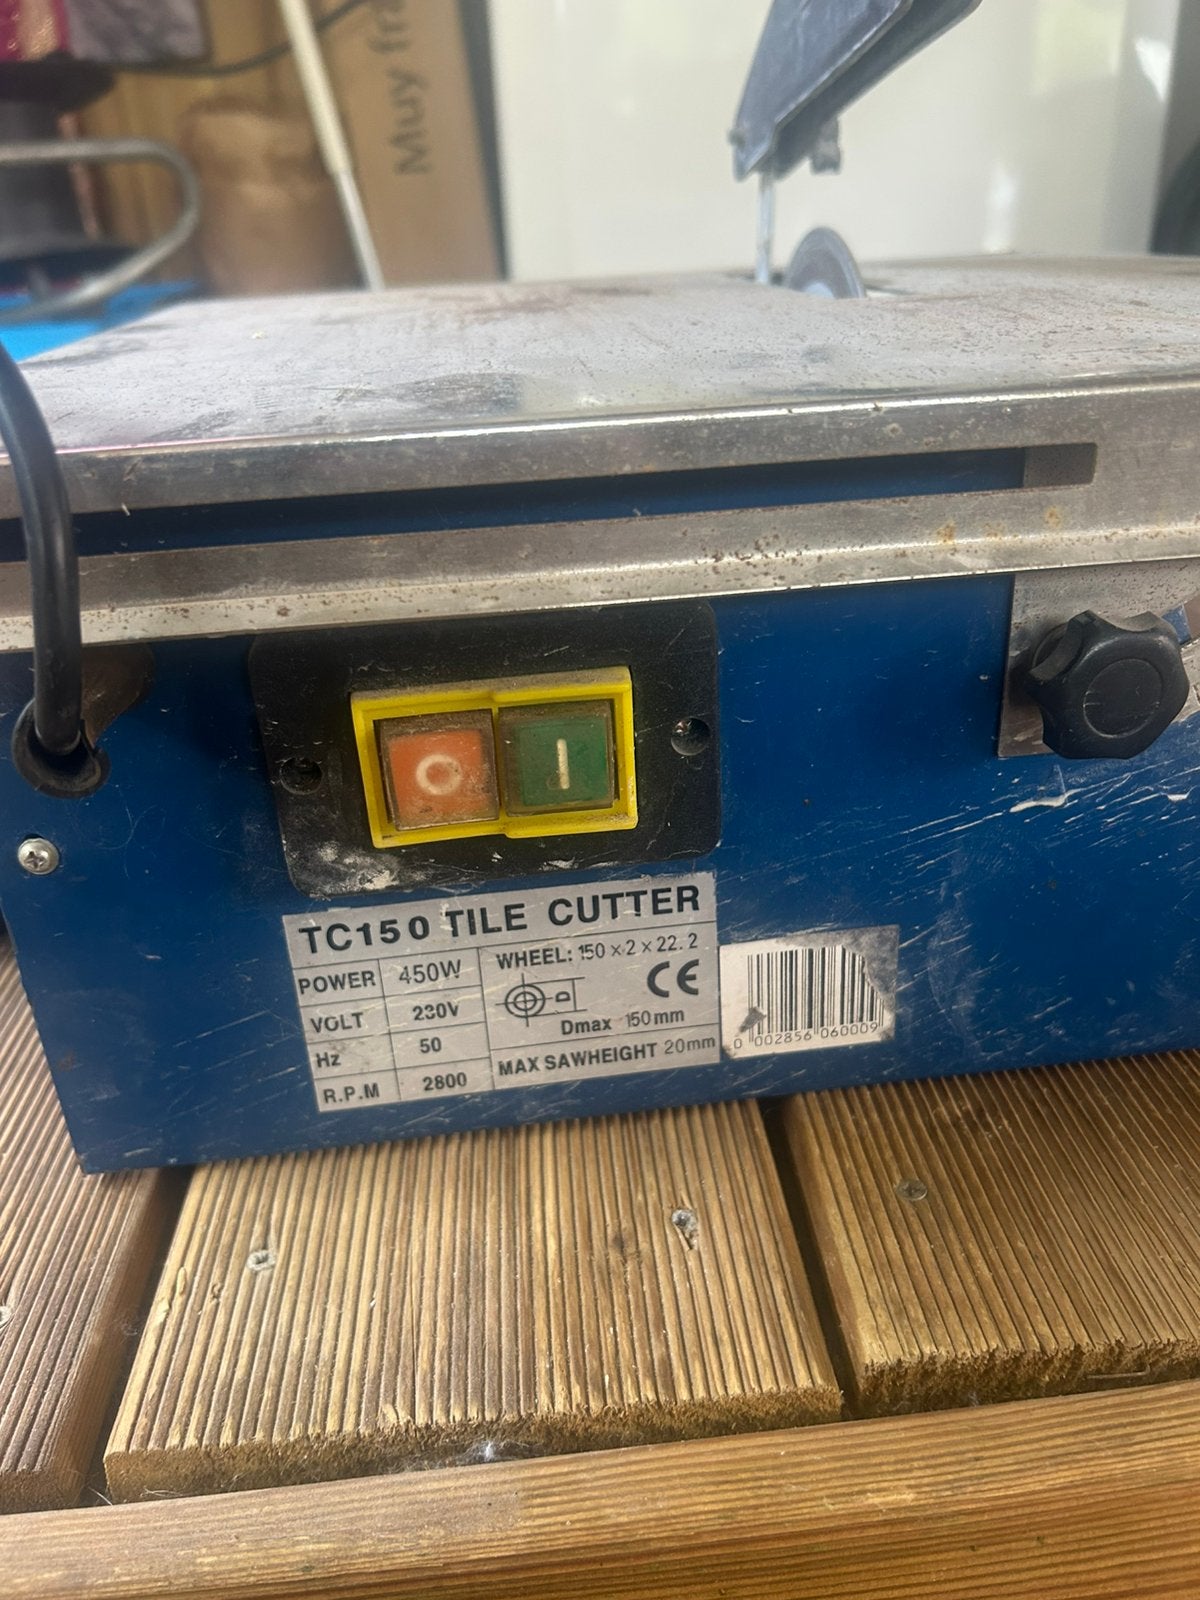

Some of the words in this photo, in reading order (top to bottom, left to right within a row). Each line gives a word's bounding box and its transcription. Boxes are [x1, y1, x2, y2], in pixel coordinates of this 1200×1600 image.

[387, 66, 433, 175] Muy
[299, 915, 431, 954] TC150
[445, 902, 528, 938] TILE
[548, 885, 700, 926] CUTTER
[496, 947, 573, 970] WHEEL:
[298, 970, 377, 995] POWER
[399, 959, 462, 985] 450W
[412, 1001, 461, 1021] 230V
[310, 1012, 363, 1033] VOLT
[561, 1018, 612, 1036] Dmax
[419, 1036, 442, 1054] 50
[316, 1052, 342, 1069] Hz
[498, 1056, 540, 1076] MAX
[545, 1042, 658, 1070] SAWHEIGHT
[323, 1082, 380, 1104] R.P.M
[422, 1072, 468, 1092] 2800
